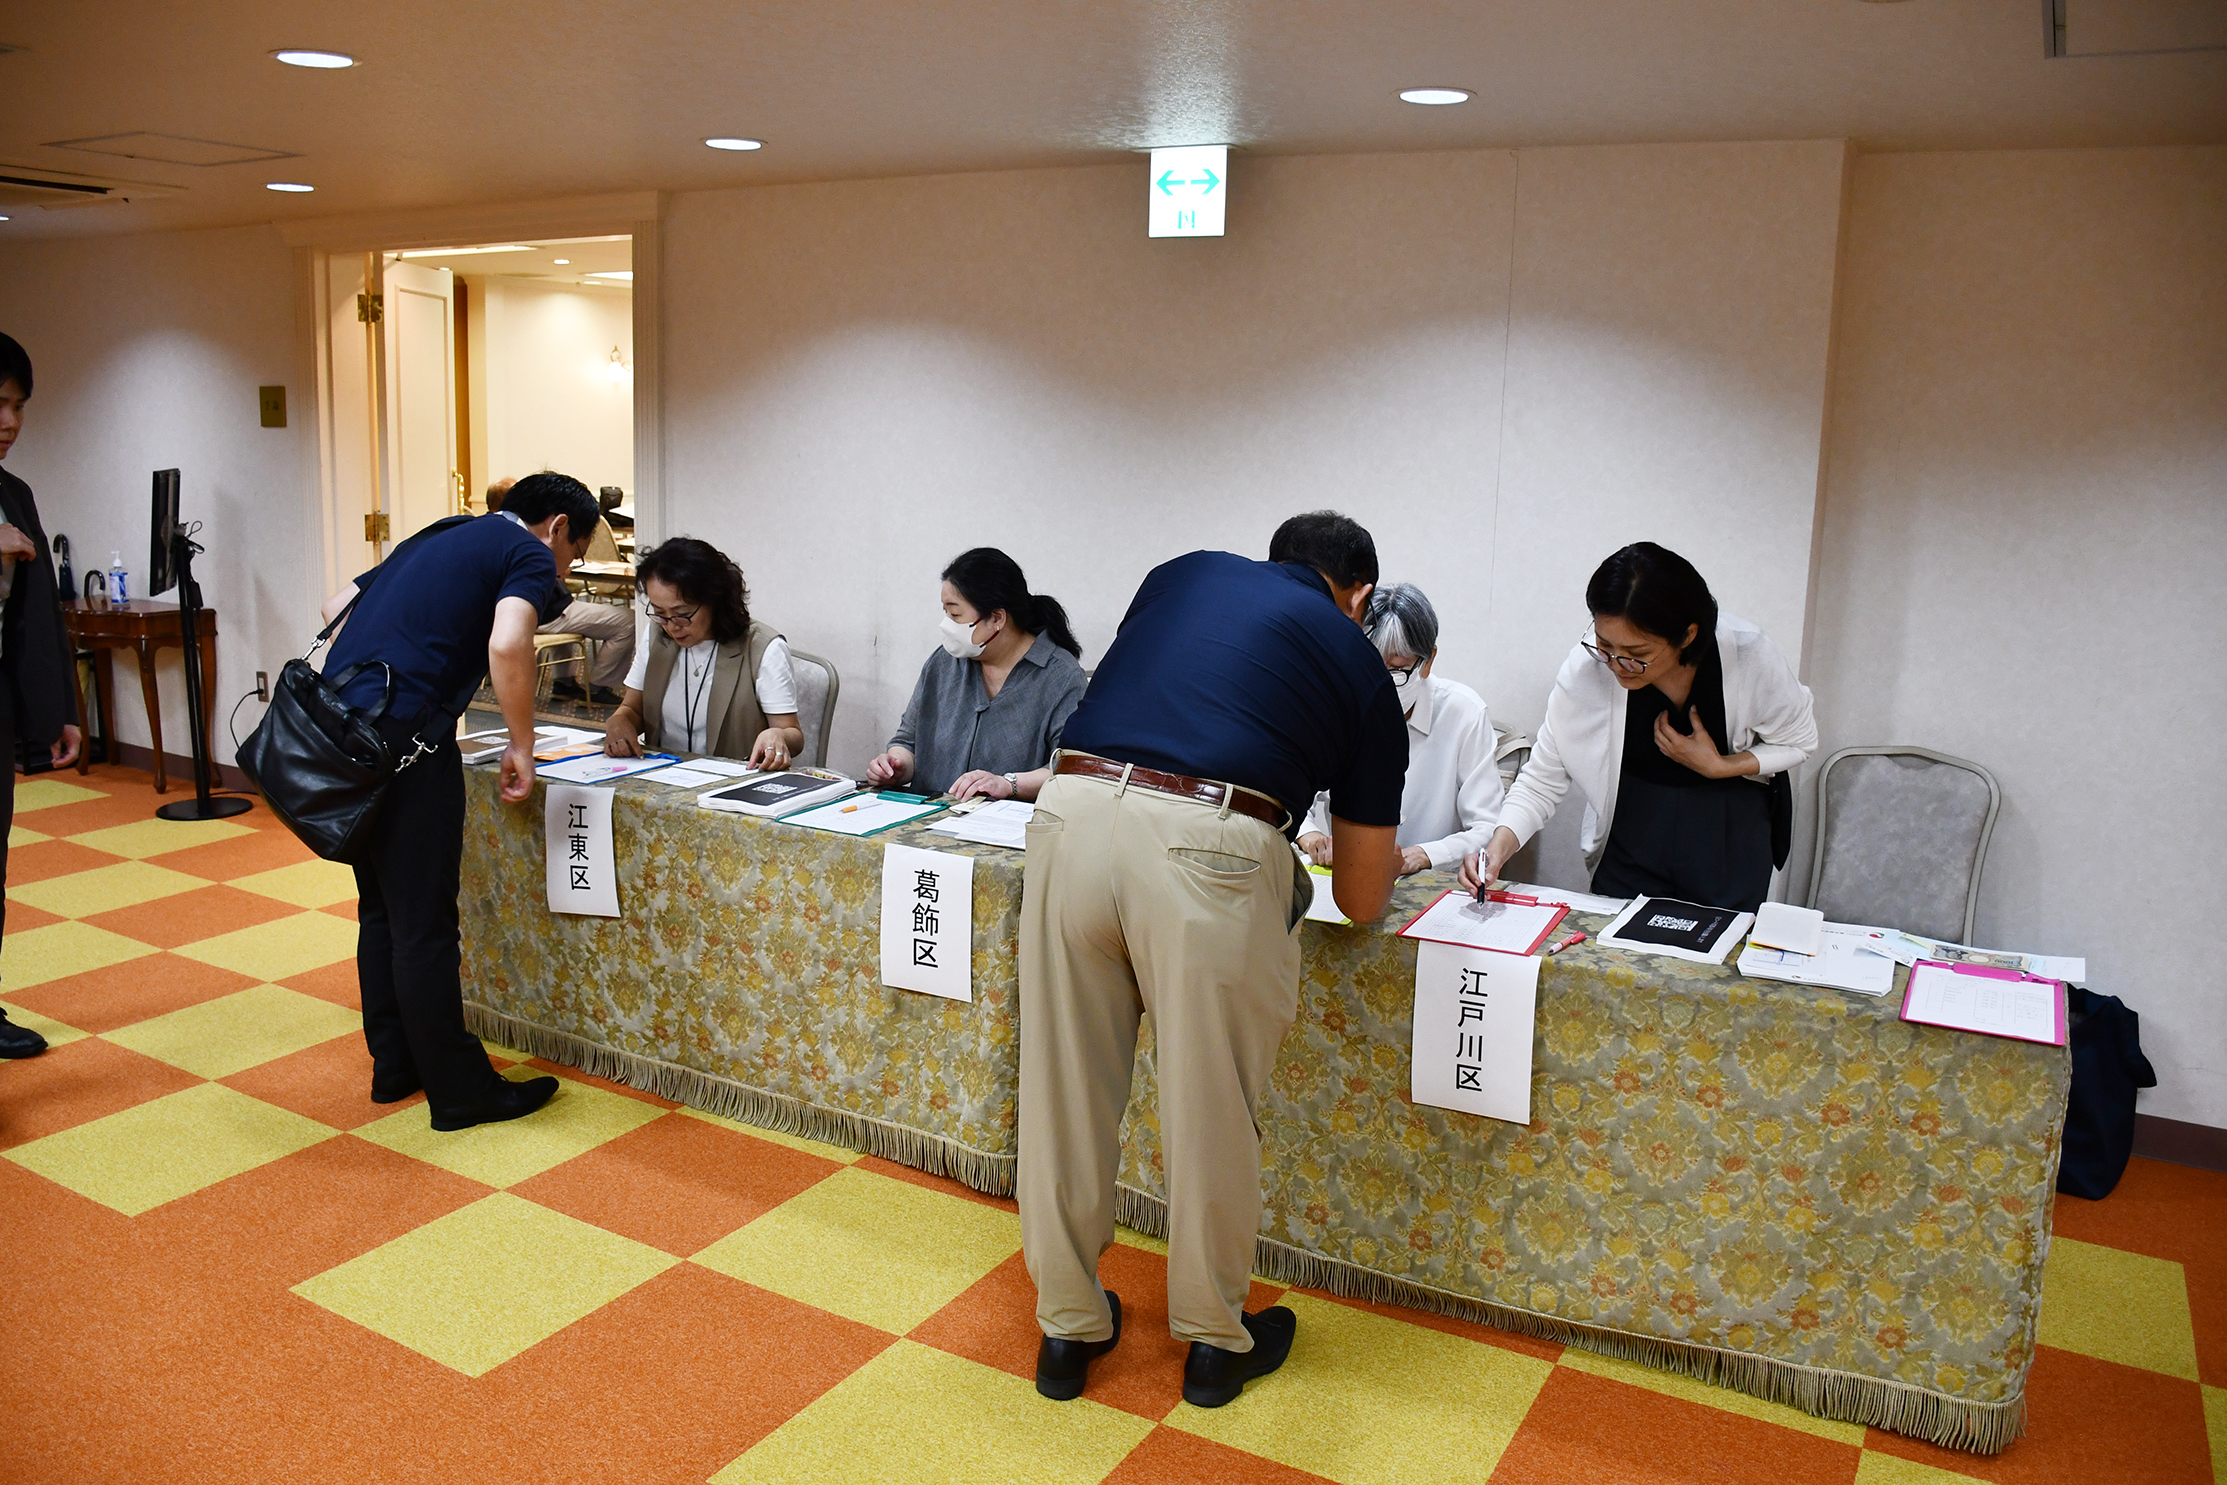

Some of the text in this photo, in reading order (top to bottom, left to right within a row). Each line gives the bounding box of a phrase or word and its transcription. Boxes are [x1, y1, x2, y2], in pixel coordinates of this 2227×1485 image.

[568, 803, 591, 891] 江東区
[911, 868, 940, 969] 葛飾区
[1455, 967, 1488, 1092] 江戸川区
